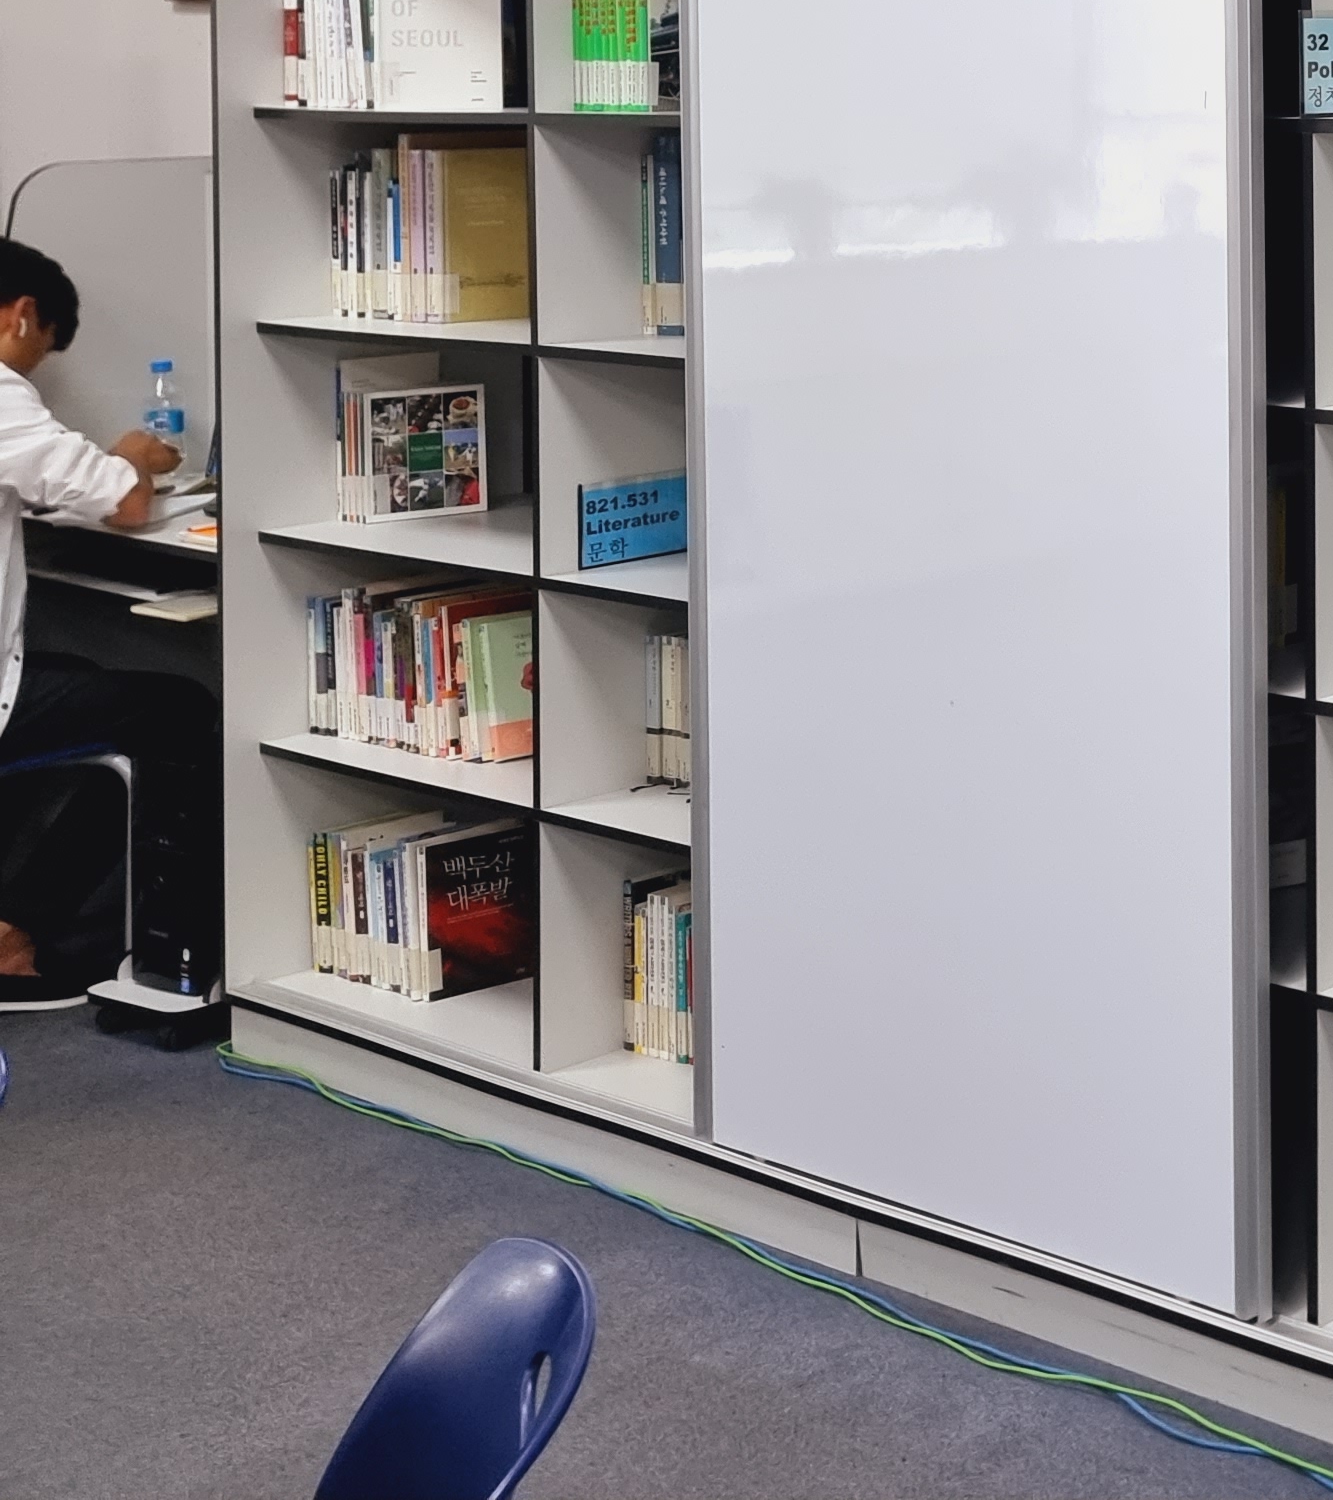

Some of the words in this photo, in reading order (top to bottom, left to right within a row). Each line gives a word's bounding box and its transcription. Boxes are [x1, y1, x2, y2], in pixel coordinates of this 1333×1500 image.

[390, 0, 418, 17] OF
[390, 29, 464, 48] SEOUL
[1307, 33, 1330, 51] 32
[585, 489, 659, 515] 821.531
[586, 509, 680, 536] Literature
[587, 537, 629, 563] 문학
[316, 846, 327, 877] ONLY
[442, 851, 515, 880] 백두산
[316, 880, 328, 915] CHILD
[446, 876, 514, 911] 대폭발
